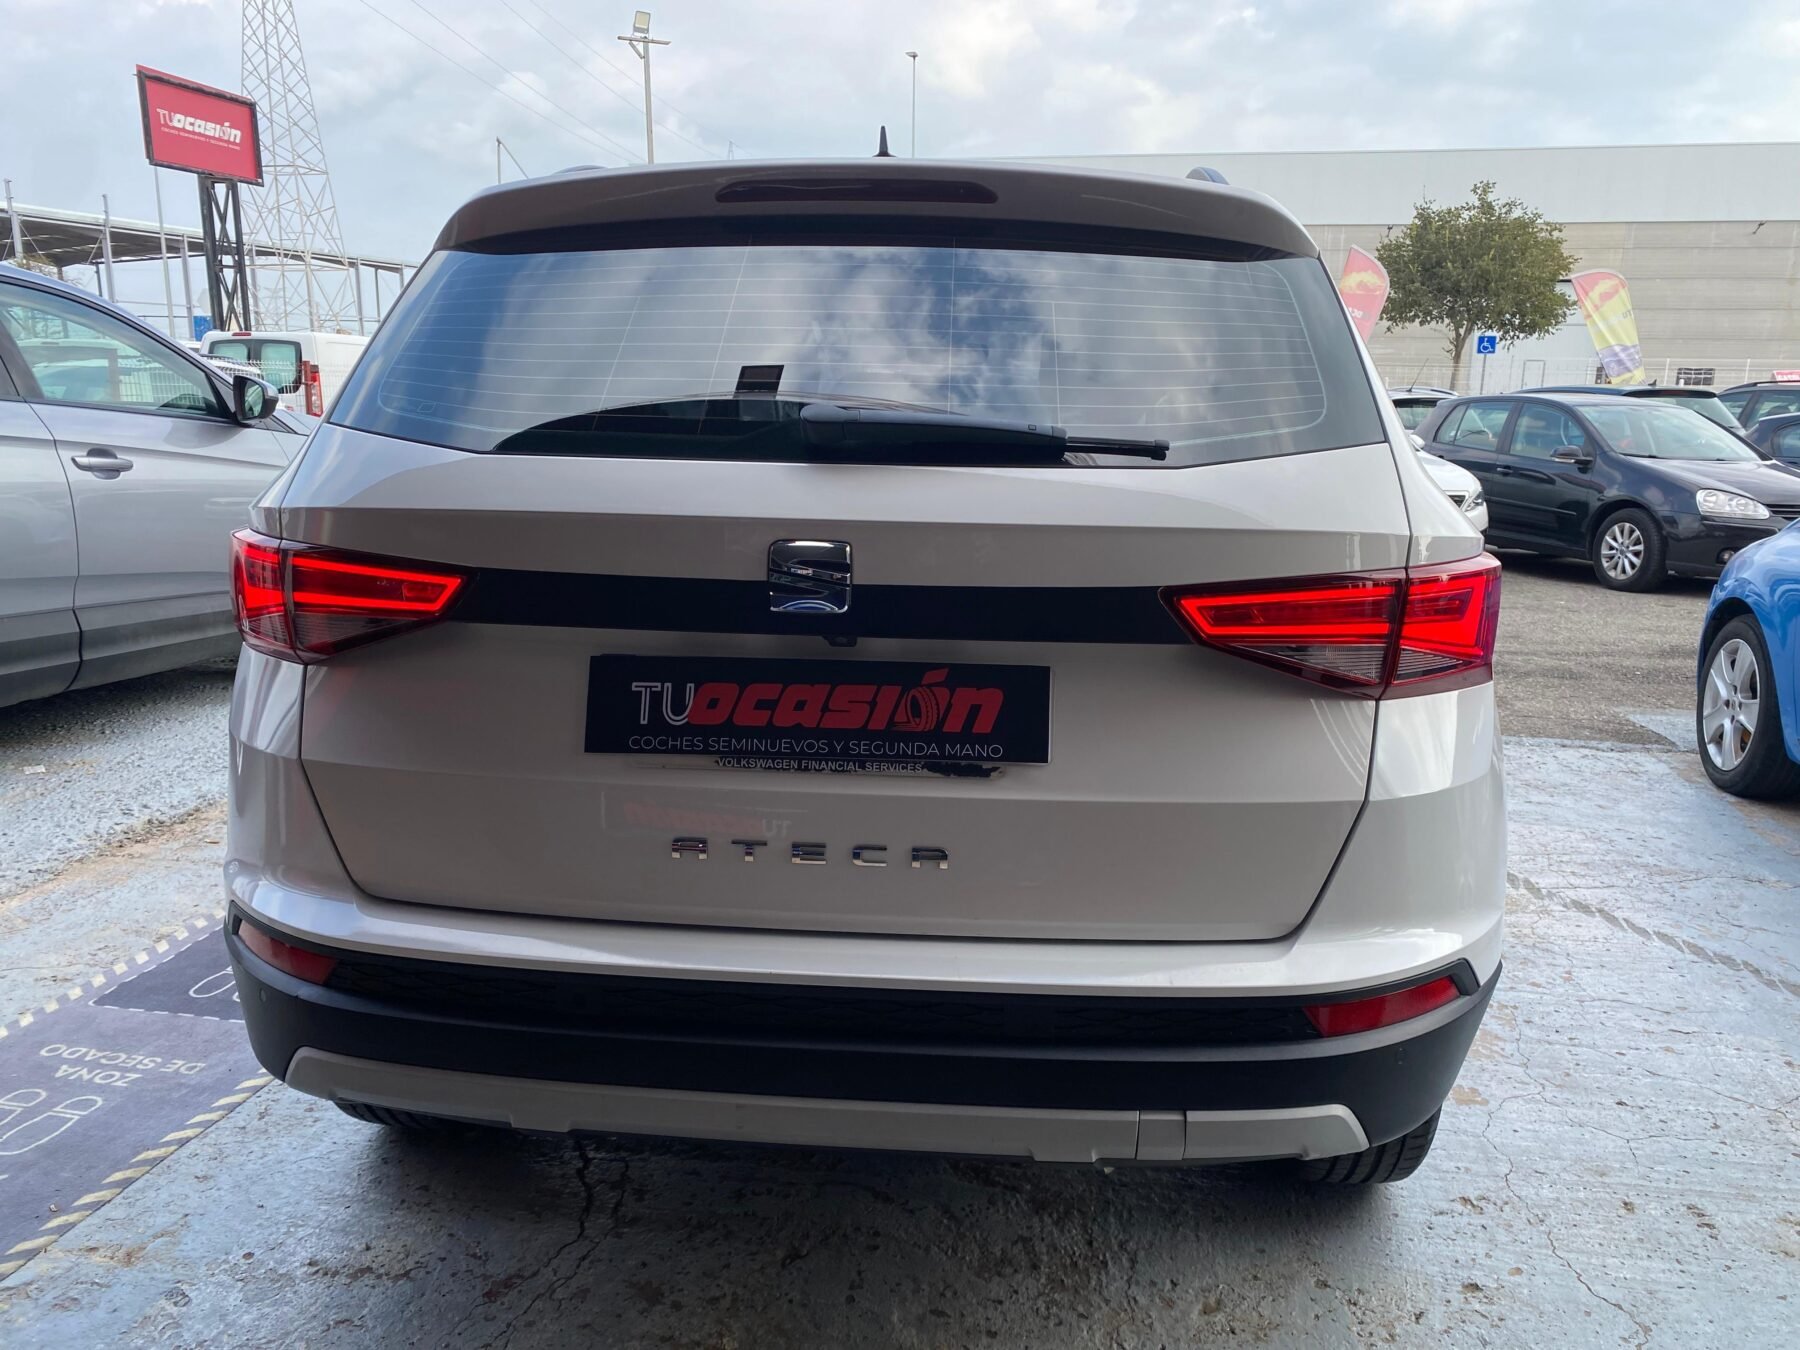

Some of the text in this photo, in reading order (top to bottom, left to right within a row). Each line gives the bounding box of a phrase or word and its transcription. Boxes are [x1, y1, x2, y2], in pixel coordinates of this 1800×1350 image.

[628, 735, 1004, 758] COCHES SEMINUEVOS Y SEGUNDA MANO
[717, 756, 922, 774] VOLKSWAGEN FINANCIAL SERVICES
[671, 836, 949, 869] ATECA
[38, 1043, 207, 1076] DE SECADO
[54, 1064, 144, 1088] ZONA
